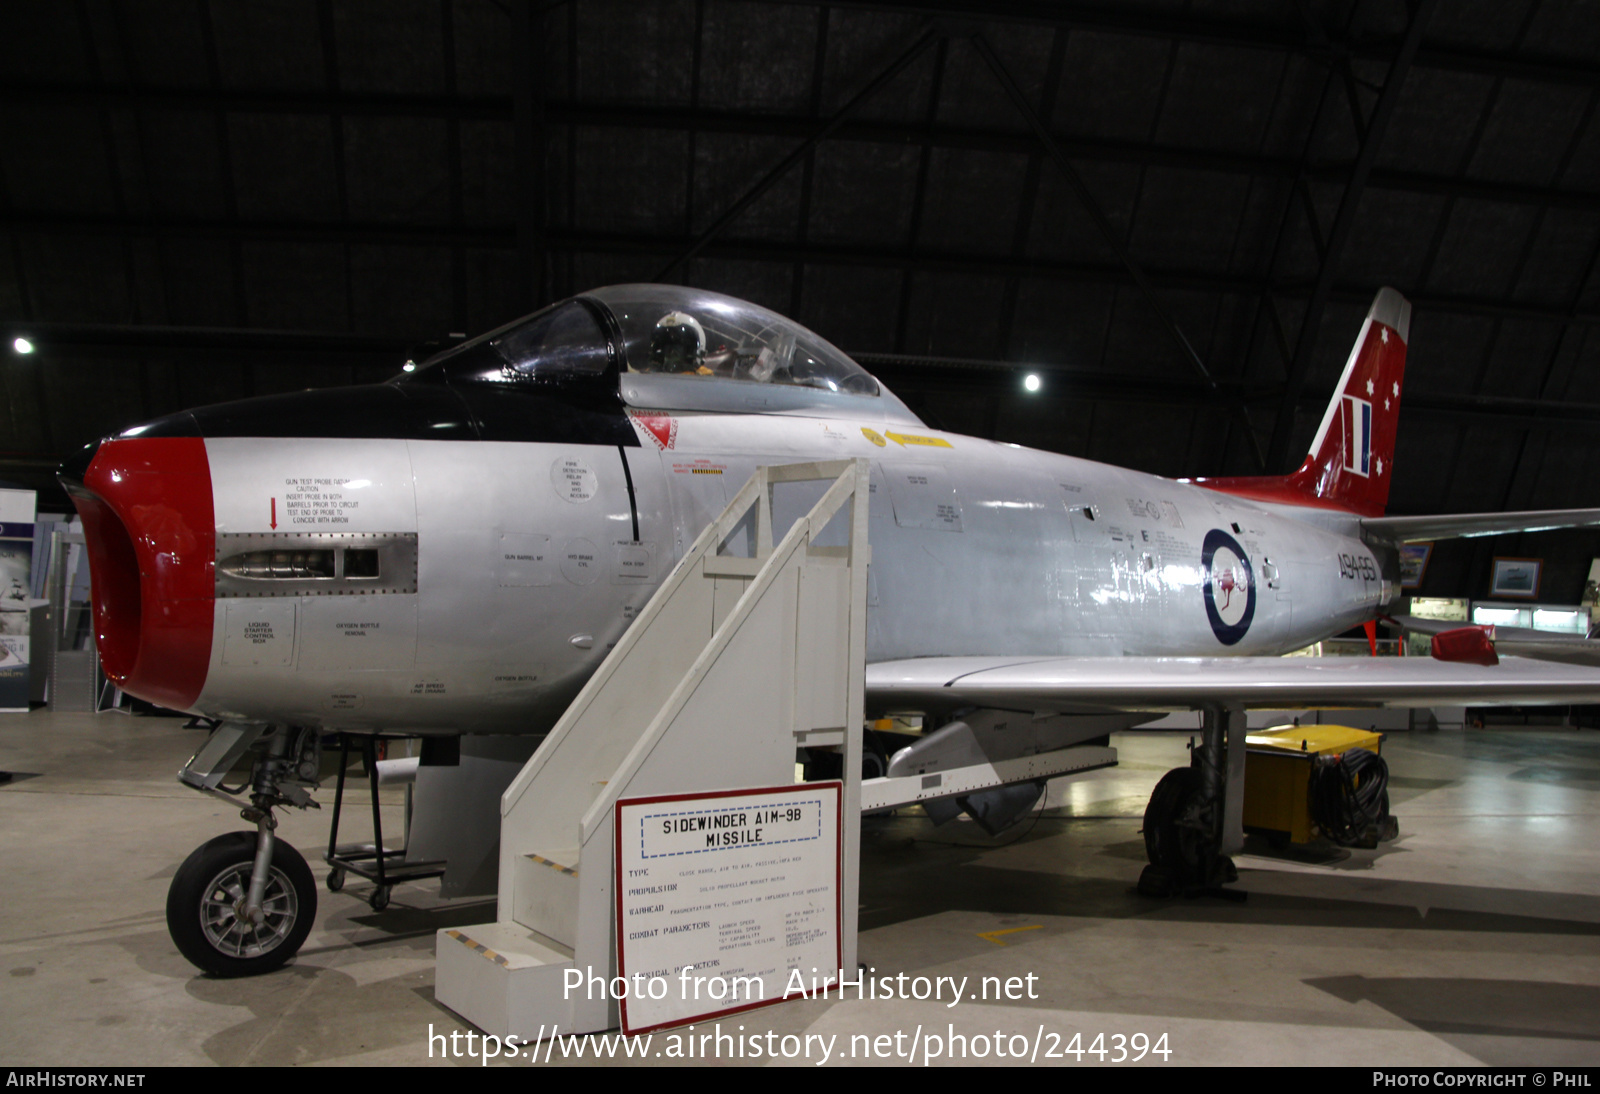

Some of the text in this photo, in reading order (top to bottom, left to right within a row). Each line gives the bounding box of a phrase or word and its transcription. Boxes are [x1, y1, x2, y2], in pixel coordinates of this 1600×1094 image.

[629, 416, 665, 452] DANGER
[668, 419, 679, 450] DANGER
[1141, 530, 1148, 542] E
[663, 808, 802, 834] SIDEWINDER AIM-9B
[706, 828, 763, 847] MISSILE
[629, 868, 649, 878] TYPE
[628, 883, 678, 896] PROPULSION
[629, 904, 664, 915] WARHEAD
[670, 904, 712, 915] FRAGMENTATION
[629, 921, 710, 940] COMBAT PARAMETERS
